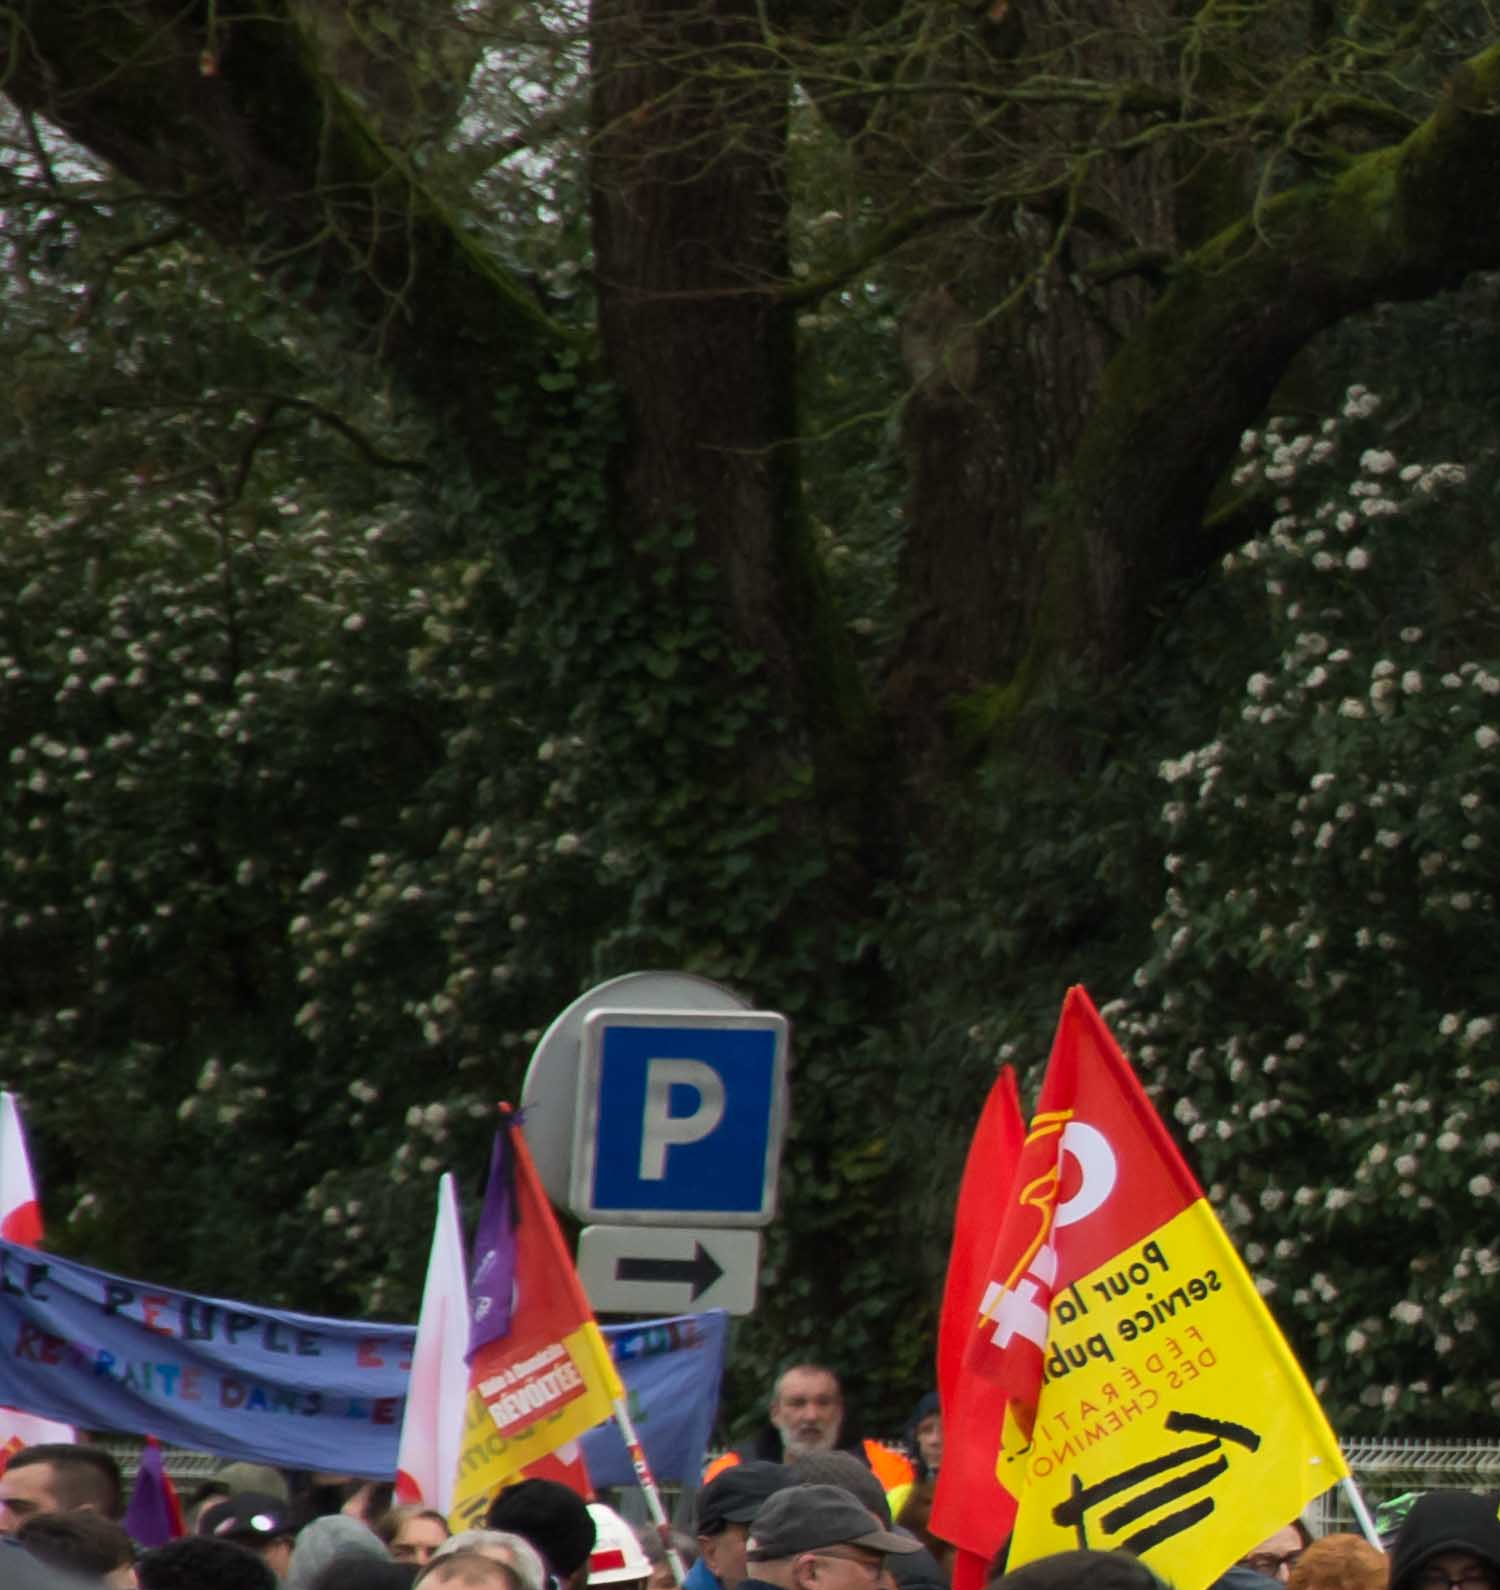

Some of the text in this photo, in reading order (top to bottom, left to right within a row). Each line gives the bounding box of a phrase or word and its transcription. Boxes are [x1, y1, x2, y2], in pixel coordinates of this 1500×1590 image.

[639, 1057, 726, 1181] P
[104, 1279, 323, 1358] PEUPLE
[16, 1322, 202, 1399] RETRAITE
